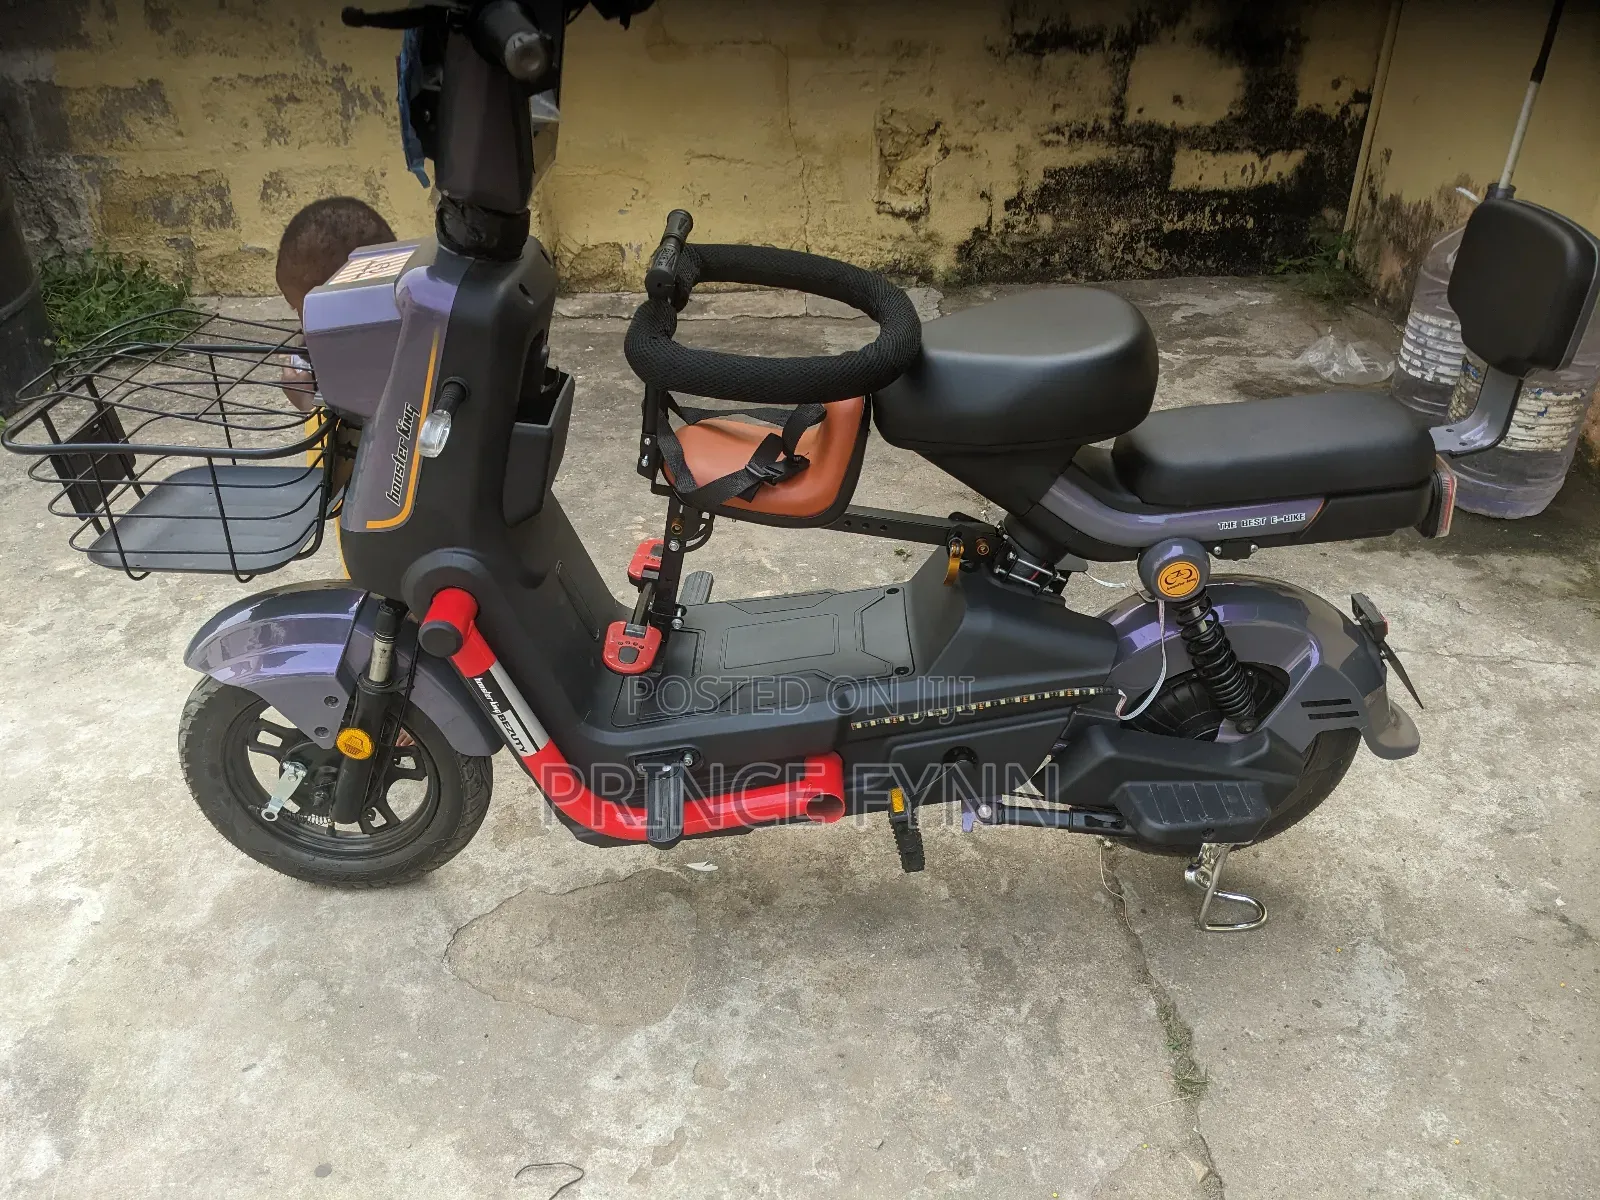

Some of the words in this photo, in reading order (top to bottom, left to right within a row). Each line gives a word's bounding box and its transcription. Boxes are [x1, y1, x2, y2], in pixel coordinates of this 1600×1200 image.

[385, 436, 408, 507] booster
[1218, 520, 1237, 530] THE
[1241, 517, 1267, 527] BEST
[1271, 513, 1306, 524] E-BIKE
[497, 713, 528, 753] BEZUTY
